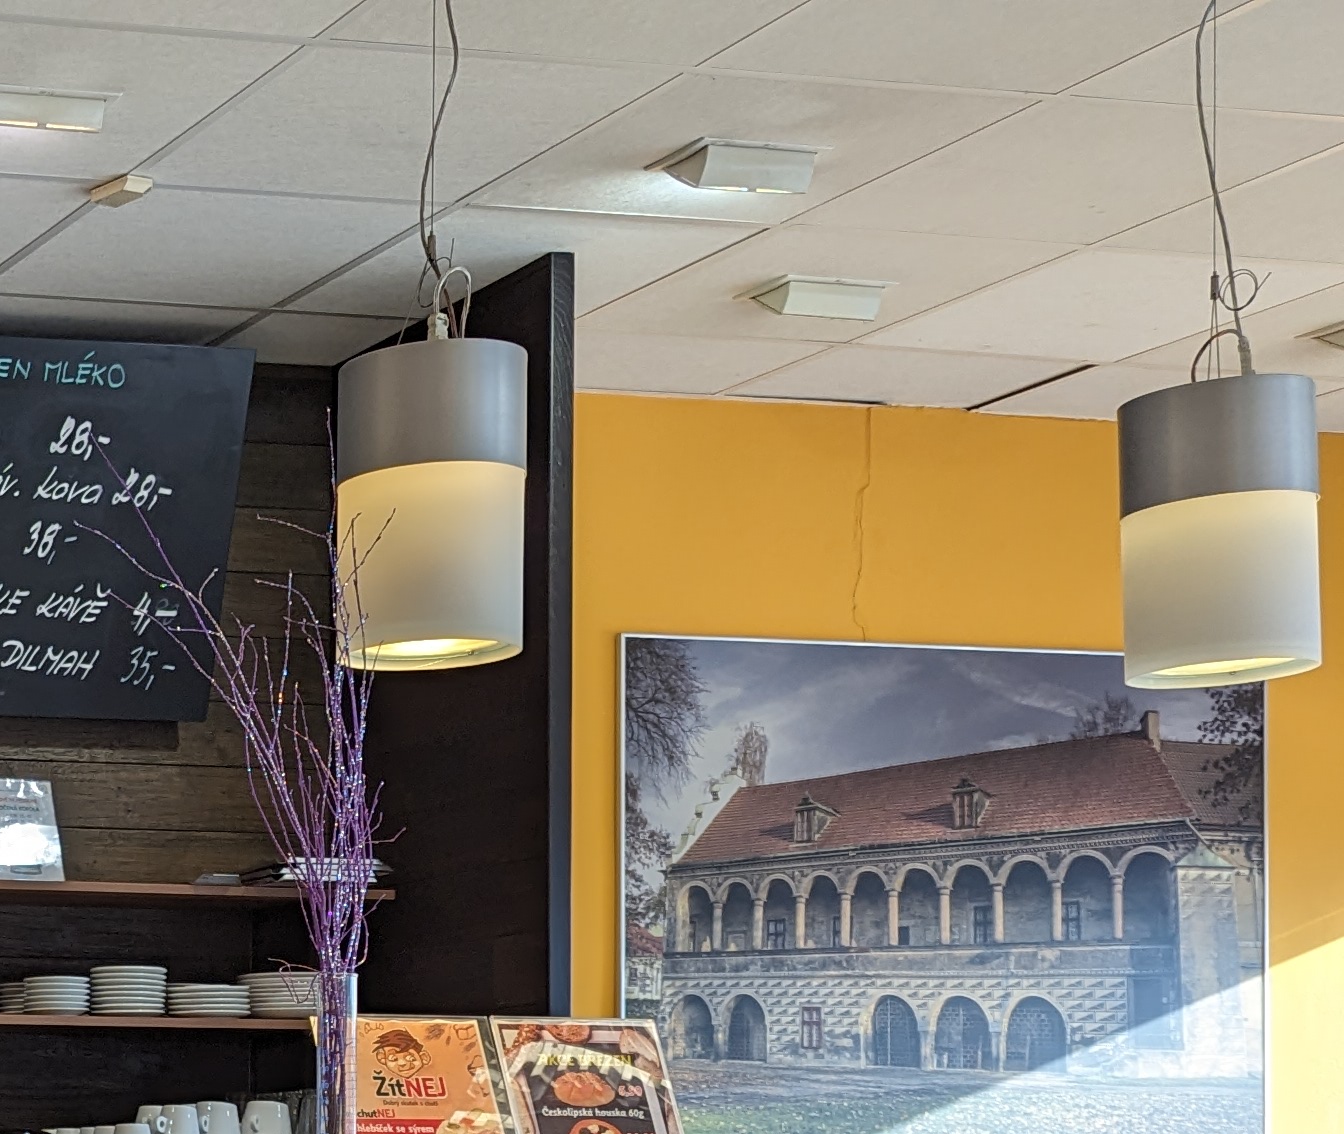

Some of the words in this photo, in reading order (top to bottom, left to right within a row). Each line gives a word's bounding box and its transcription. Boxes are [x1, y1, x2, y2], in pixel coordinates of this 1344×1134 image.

[44, 351, 126, 388] MLÉKO
[50, 415, 110, 460] 28,-
[112, 468, 172, 511] 28,-
[23, 523, 77, 564] 38,-
[36, 586, 112, 624] KÁVĚ
[1, 639, 100, 680] DILMAH
[120, 646, 176, 691] 35,-
[373, 1070, 448, 1097] ŽítNEJ
[357, 1109, 395, 1118] chutNEJ
[595, 1108, 626, 1117] houska
[629, 1109, 644, 1119] 60g
